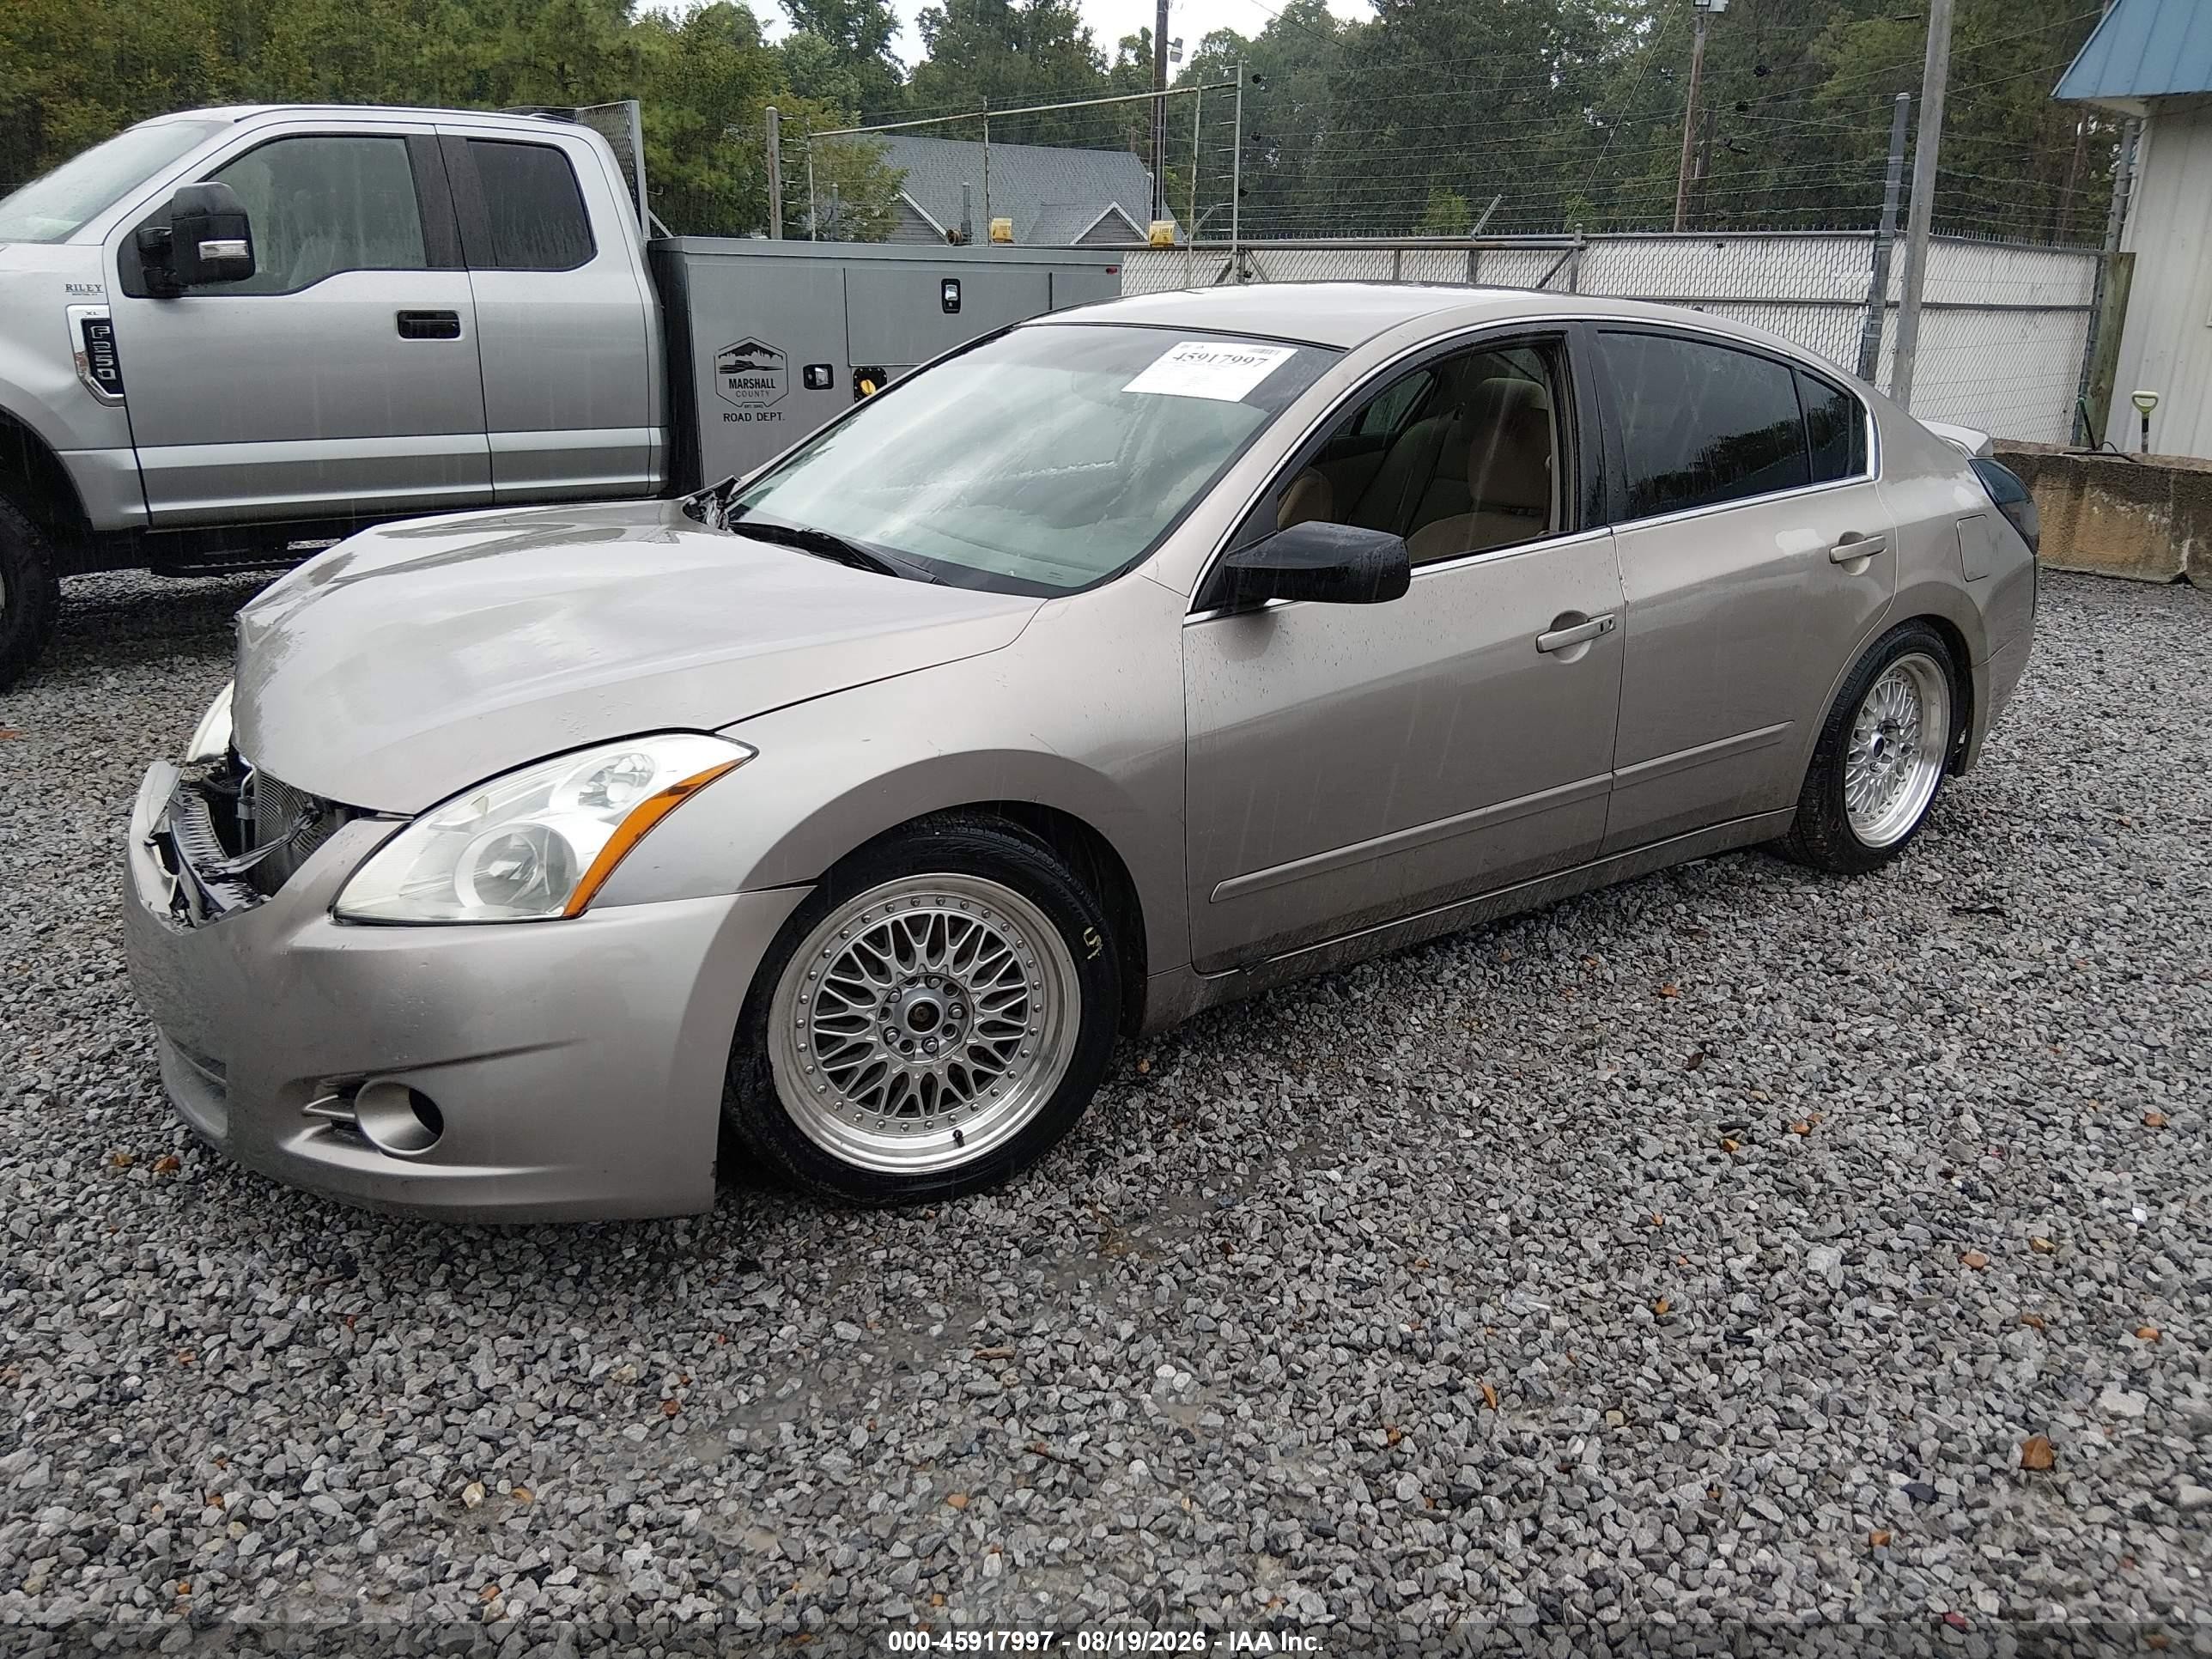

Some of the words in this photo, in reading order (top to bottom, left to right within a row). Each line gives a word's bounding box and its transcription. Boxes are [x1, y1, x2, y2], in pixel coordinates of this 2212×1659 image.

[65, 283, 102, 292] RILEY
[1172, 352, 1269, 368] 45917997
[728, 378, 776, 389] MARSHALL
[723, 412, 752, 422] ROAD
[757, 411, 786, 422] DEPT.
